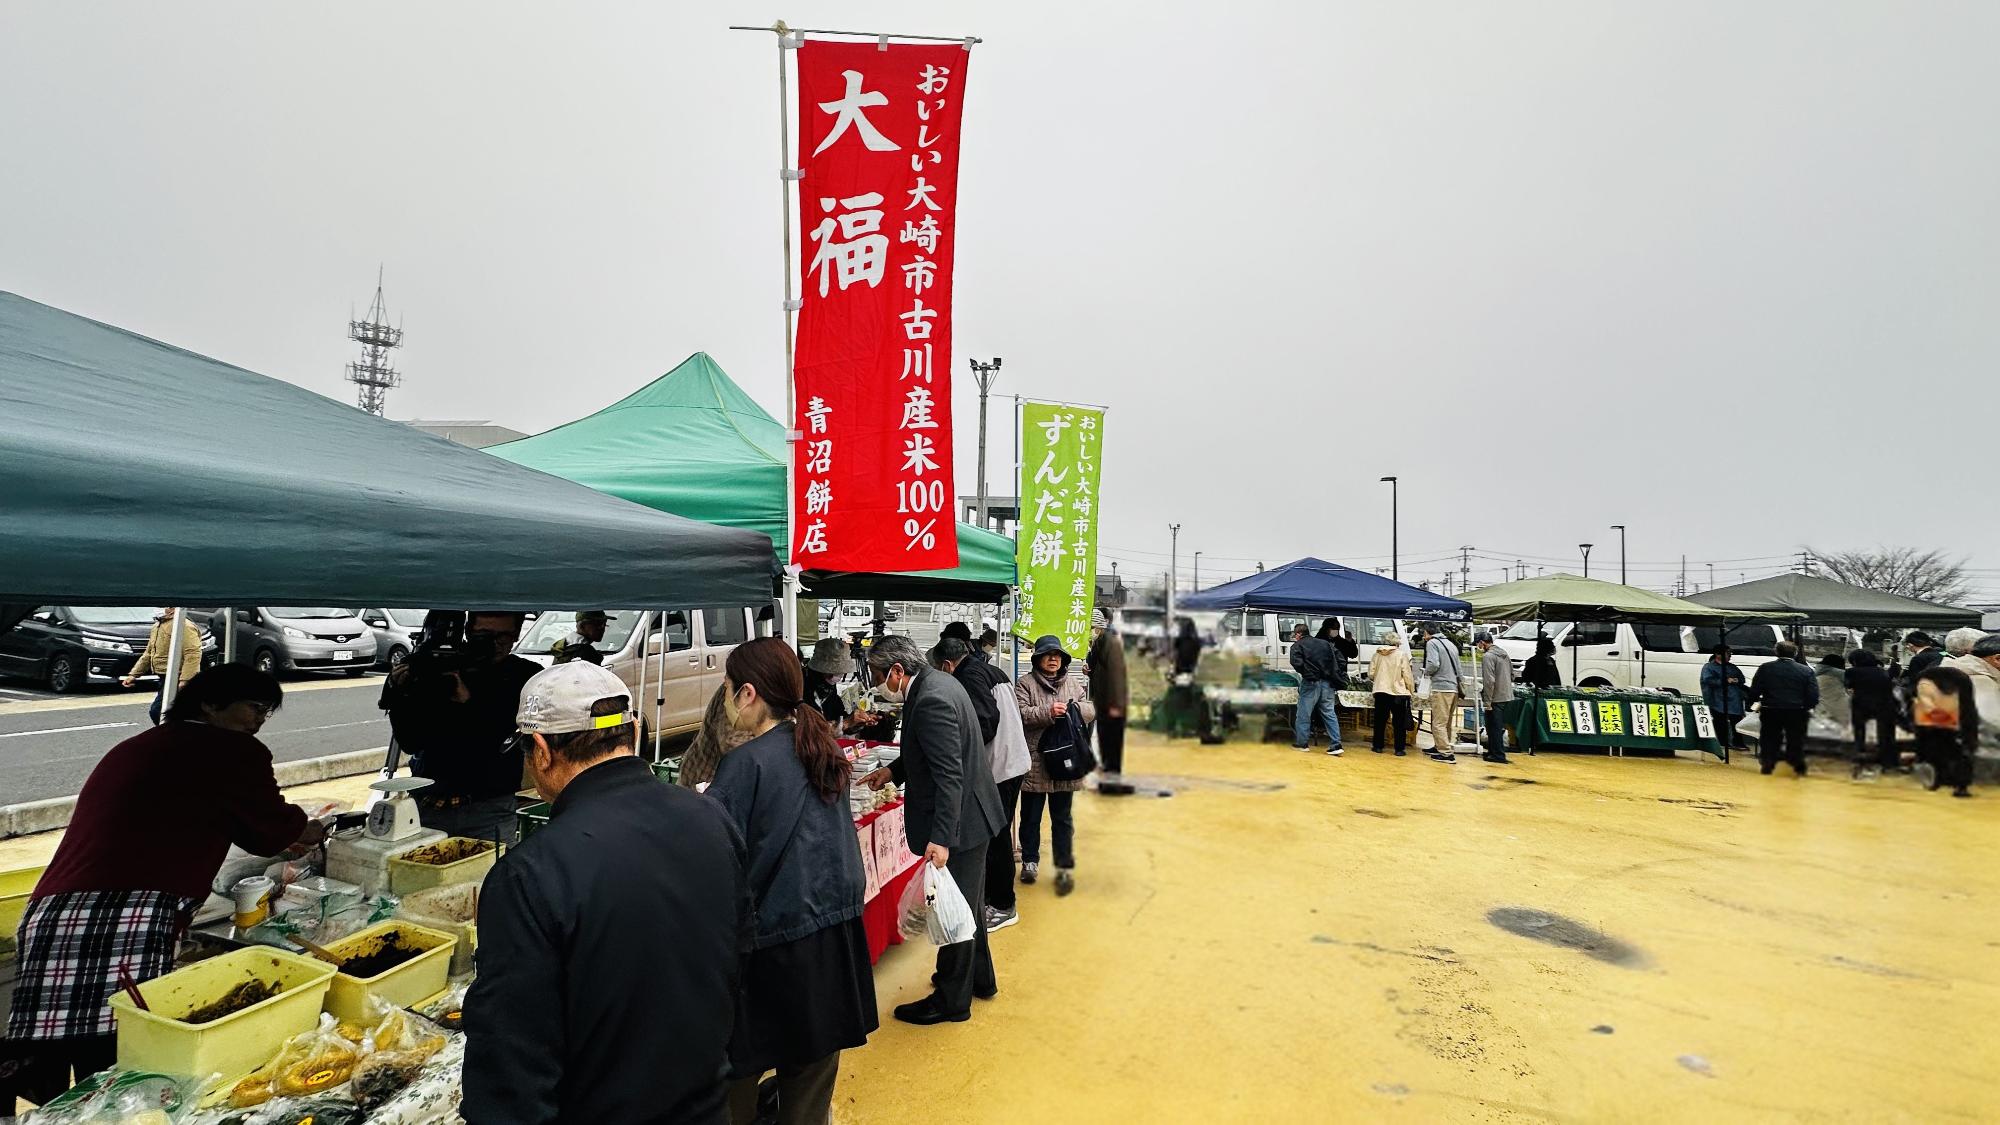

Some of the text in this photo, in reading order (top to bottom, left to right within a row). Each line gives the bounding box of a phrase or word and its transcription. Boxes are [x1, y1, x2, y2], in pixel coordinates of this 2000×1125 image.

[807, 69, 902, 299] 大福
[896, 63, 951, 551] おいしい大崎市古川産米100%
[799, 396, 834, 554] 青沼餅店
[1031, 413, 1075, 571] ずんだ餅
[1634, 704, 1645, 736] ひじき
[1669, 705, 1682, 737] ふのり
